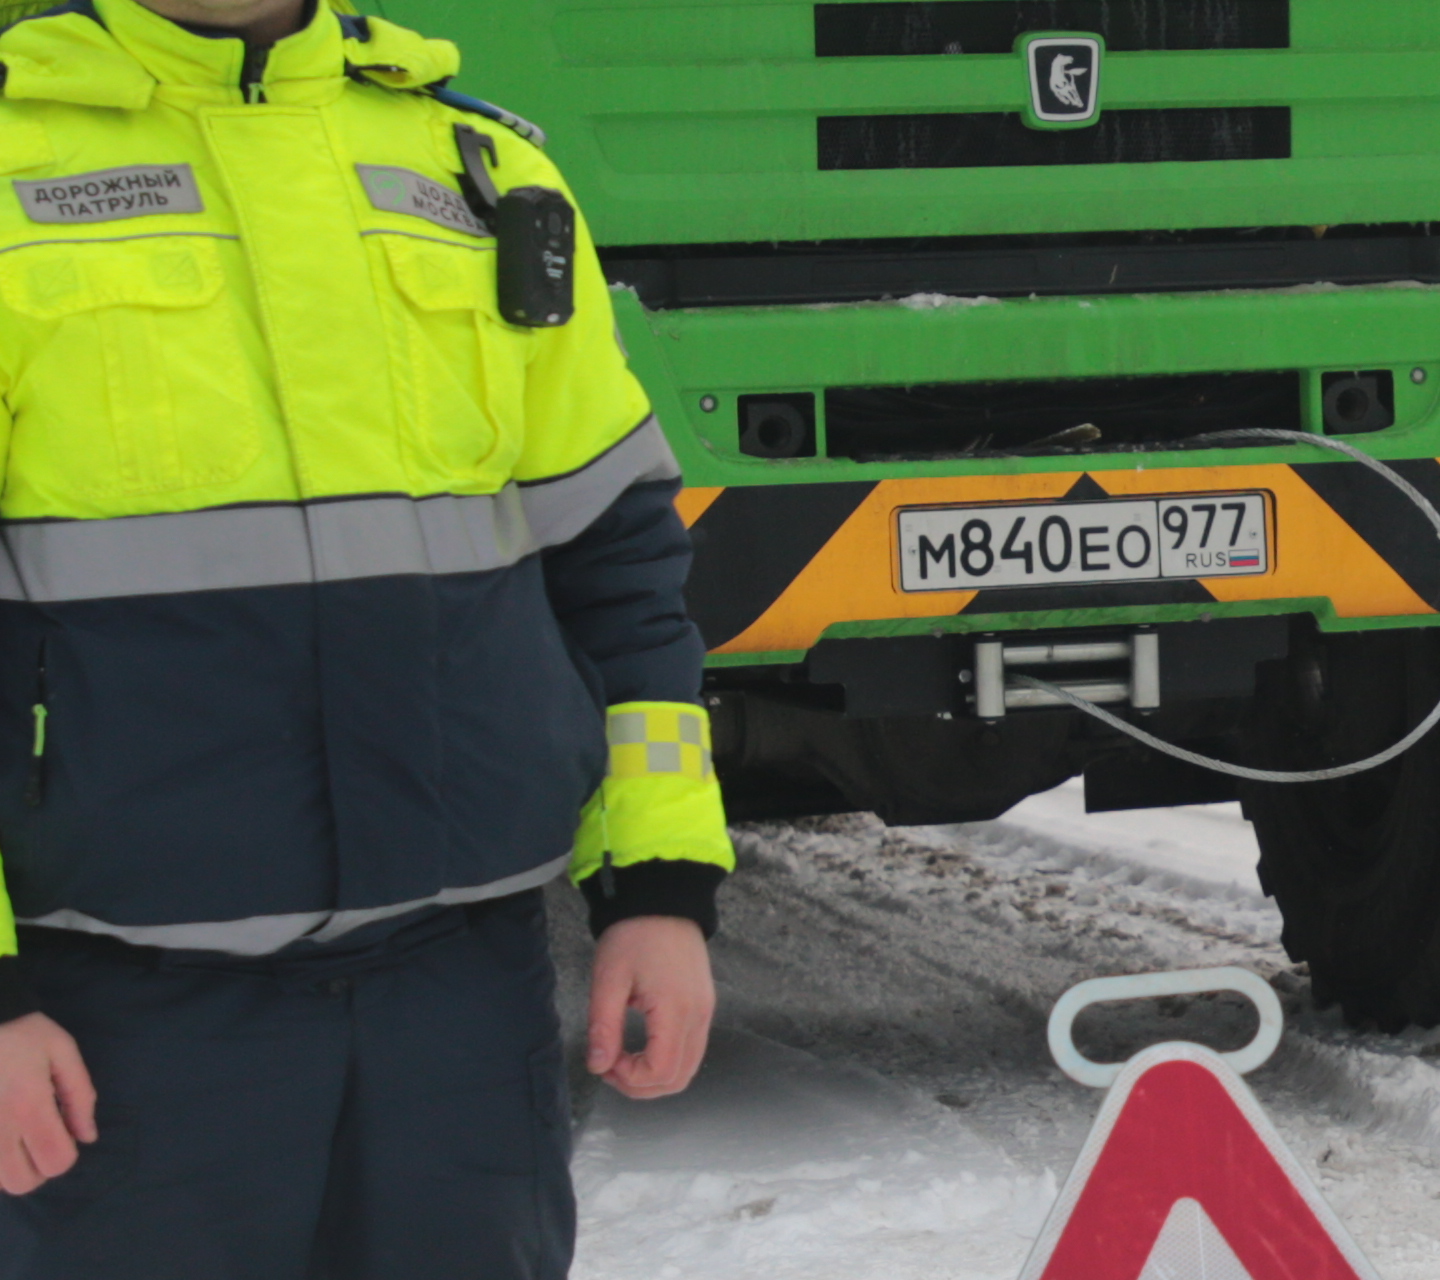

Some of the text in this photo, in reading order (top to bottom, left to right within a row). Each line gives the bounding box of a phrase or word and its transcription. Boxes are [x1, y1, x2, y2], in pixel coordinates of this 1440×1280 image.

[34, 169, 182, 204] ДОРОЖНЫЙ
[57, 191, 169, 217] ПАТРУЛЬ
[917, 502, 1248, 581] М840ЕО 977
[1184, 551, 1227, 570] RUS
